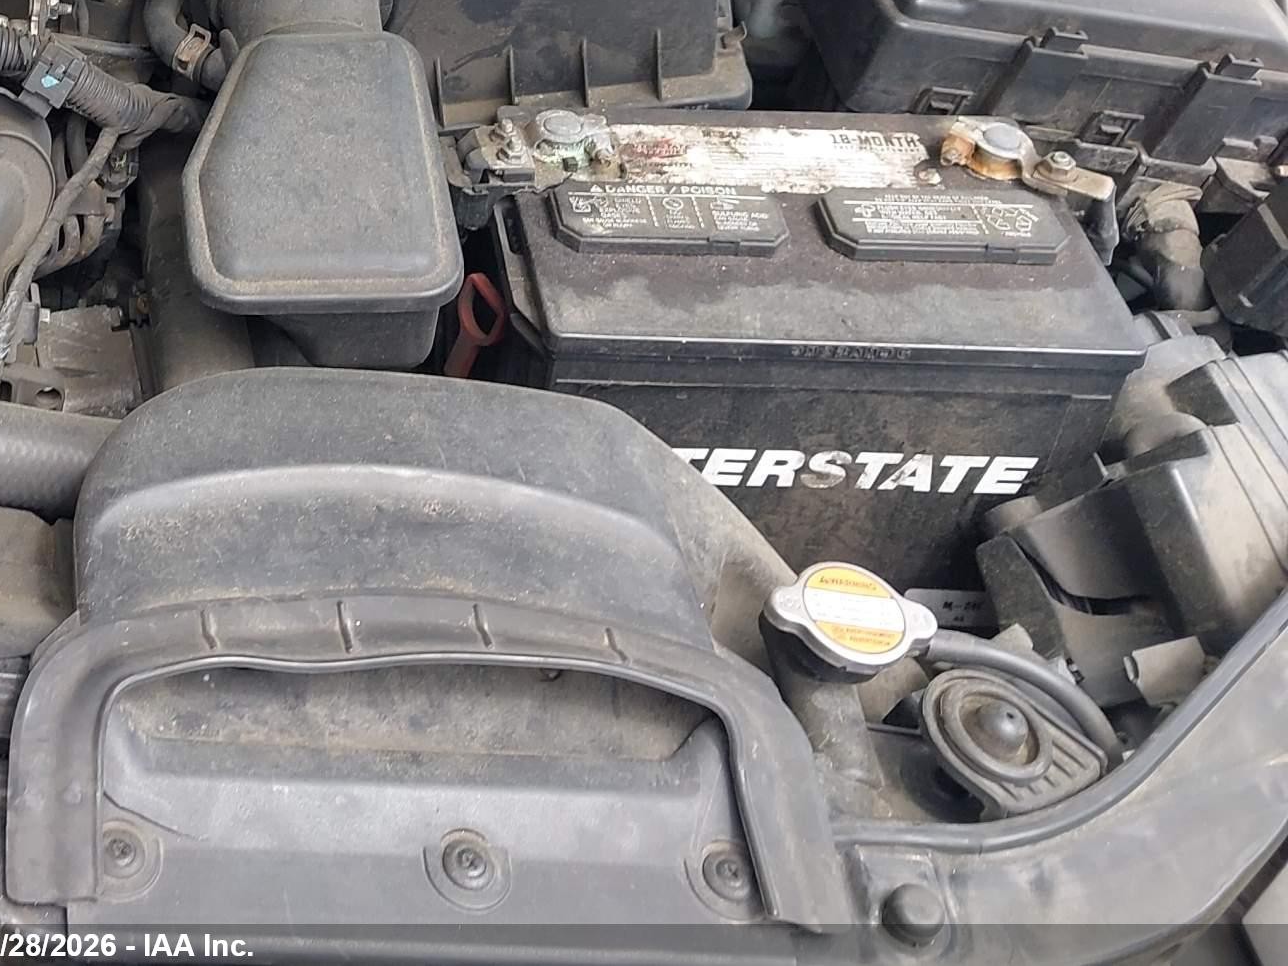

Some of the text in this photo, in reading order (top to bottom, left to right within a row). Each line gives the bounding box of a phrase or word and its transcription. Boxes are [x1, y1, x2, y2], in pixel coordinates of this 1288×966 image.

[829, 132, 918, 149] 18-MONTH
[605, 184, 668, 196] DANGER
[680, 185, 737, 197] POISON
